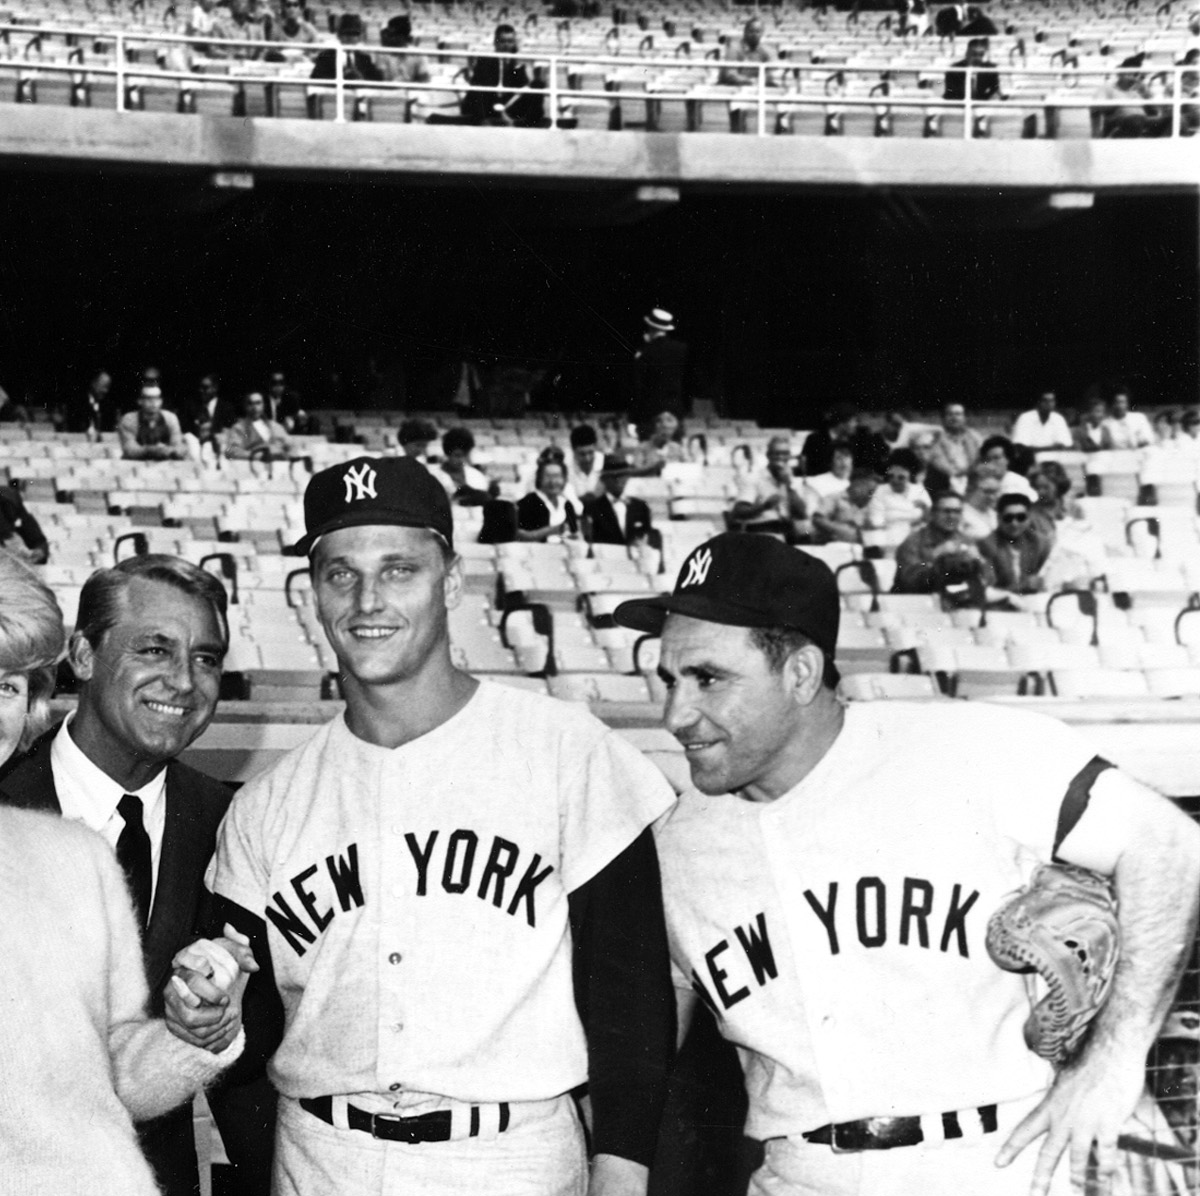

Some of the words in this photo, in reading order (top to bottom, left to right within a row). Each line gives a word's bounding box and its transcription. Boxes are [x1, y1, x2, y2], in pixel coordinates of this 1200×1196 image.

[342, 462, 378, 504] NY
[681, 548, 712, 589] NY
[265, 843, 365, 957] NEW
[404, 829, 555, 928] YORK
[803, 877, 980, 959] YORK
